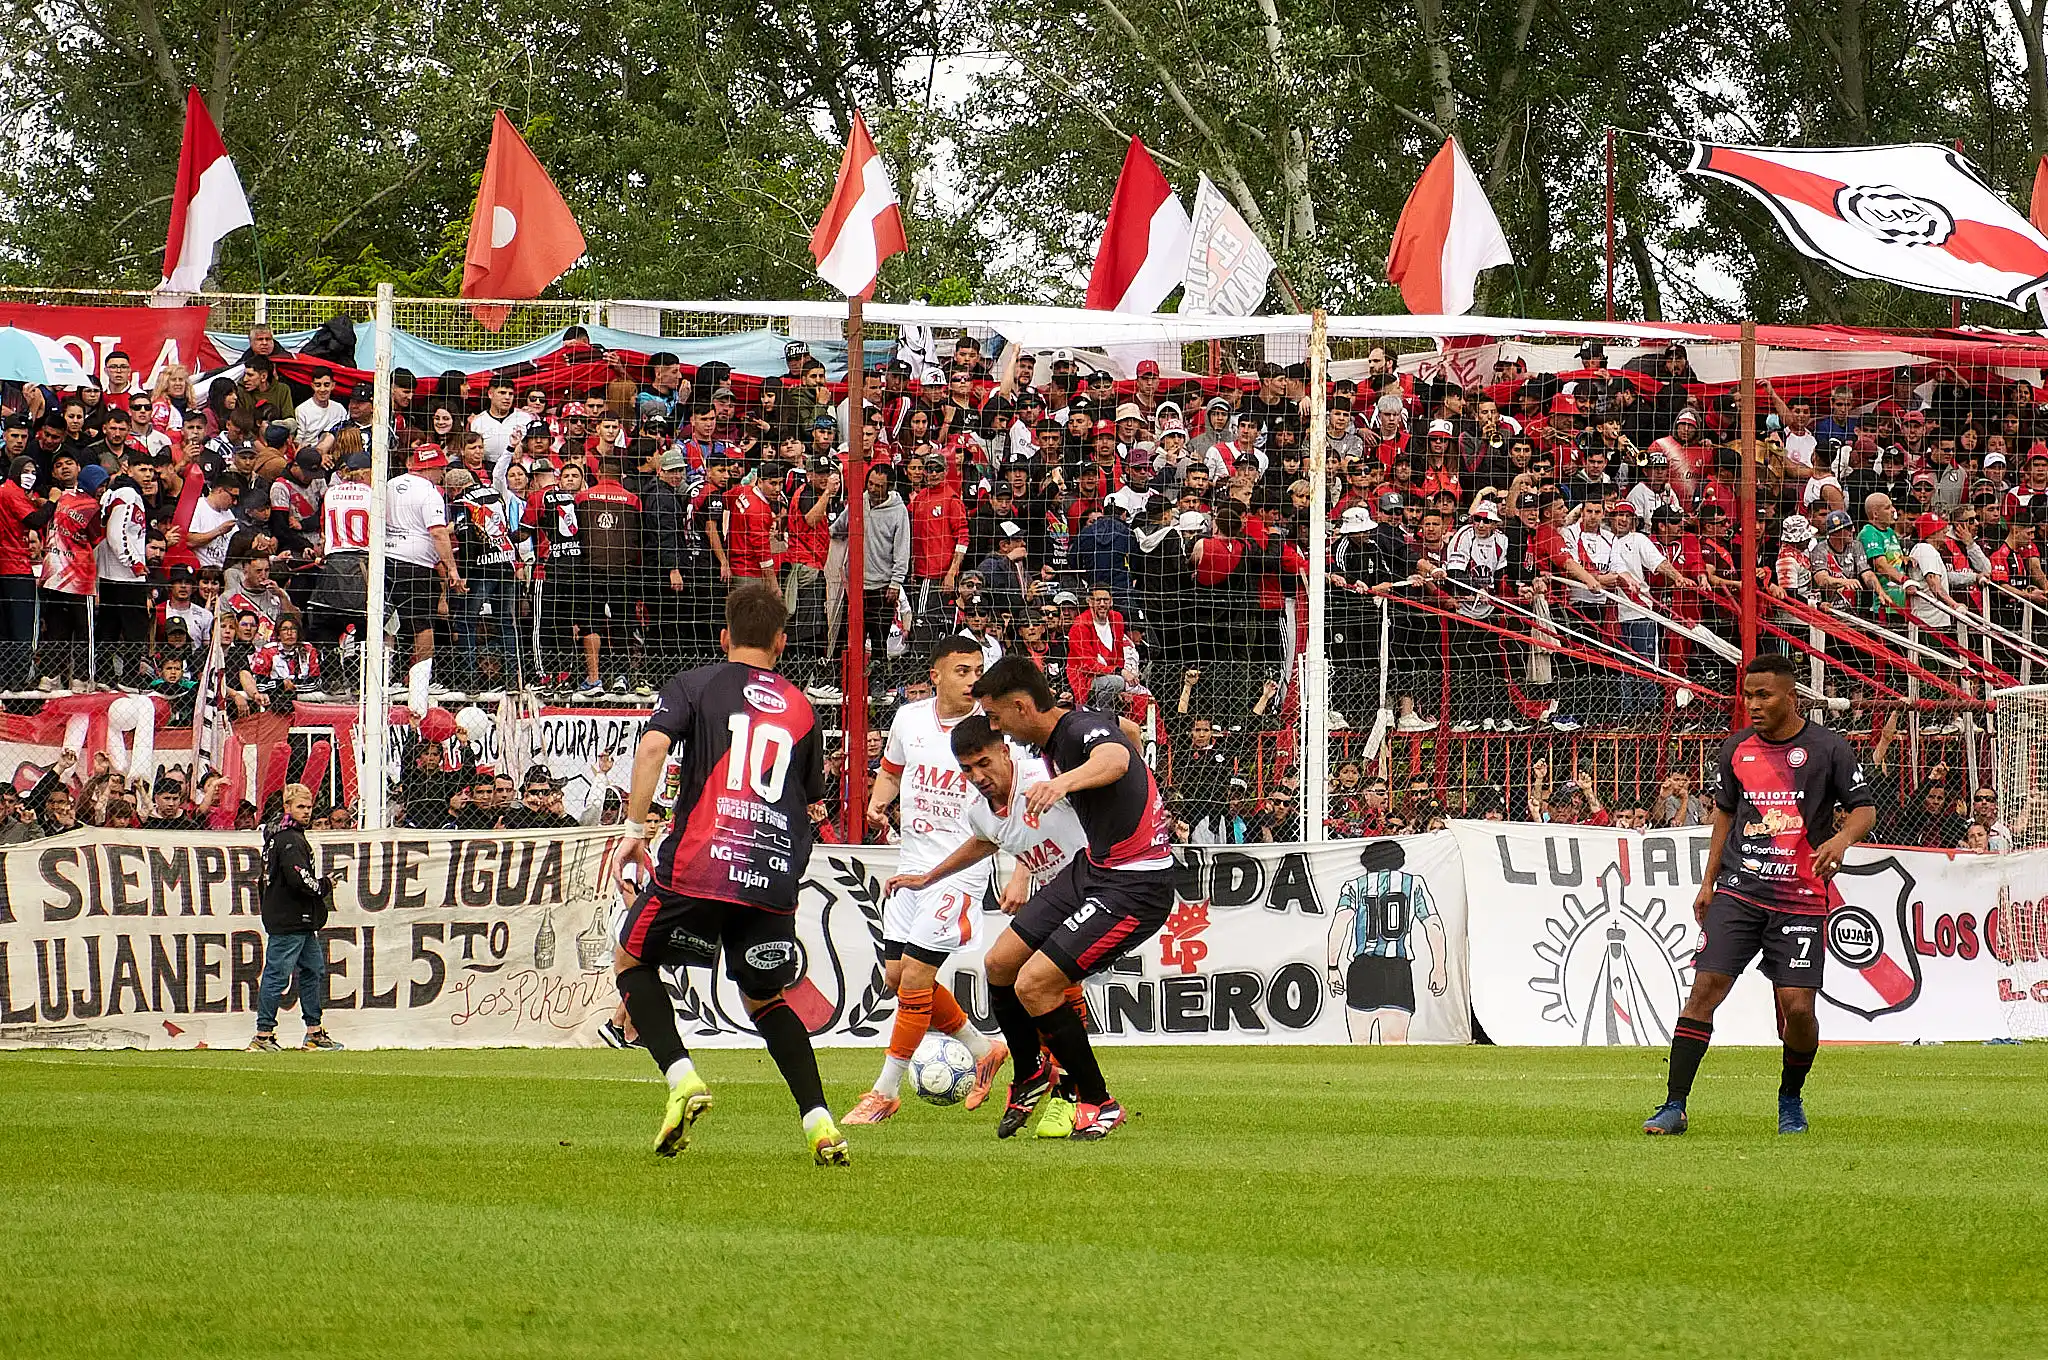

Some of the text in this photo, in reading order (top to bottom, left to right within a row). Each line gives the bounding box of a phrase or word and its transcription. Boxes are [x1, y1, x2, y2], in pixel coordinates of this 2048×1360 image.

[327, 508, 370, 548] 10
[743, 688, 786, 710] Queen
[605, 720, 630, 757] DE
[727, 713, 794, 804] 10
[912, 764, 968, 793] AMA
[716, 803, 749, 820] VIRGEN
[750, 809, 764, 823] DE
[710, 844, 732, 861] NG
[38, 844, 262, 922] SIEMPR
[320, 840, 430, 913] FUE
[729, 865, 769, 888] Luján
[934, 894, 956, 922] 2
[1075, 902, 1097, 924] 9
[1365, 890, 1406, 941] 10
[1911, 900, 1980, 960] LOS
[1797, 937, 1811, 959] 7
[0, 931, 300, 1023] LUJANER
[319, 926, 399, 1013] EL
